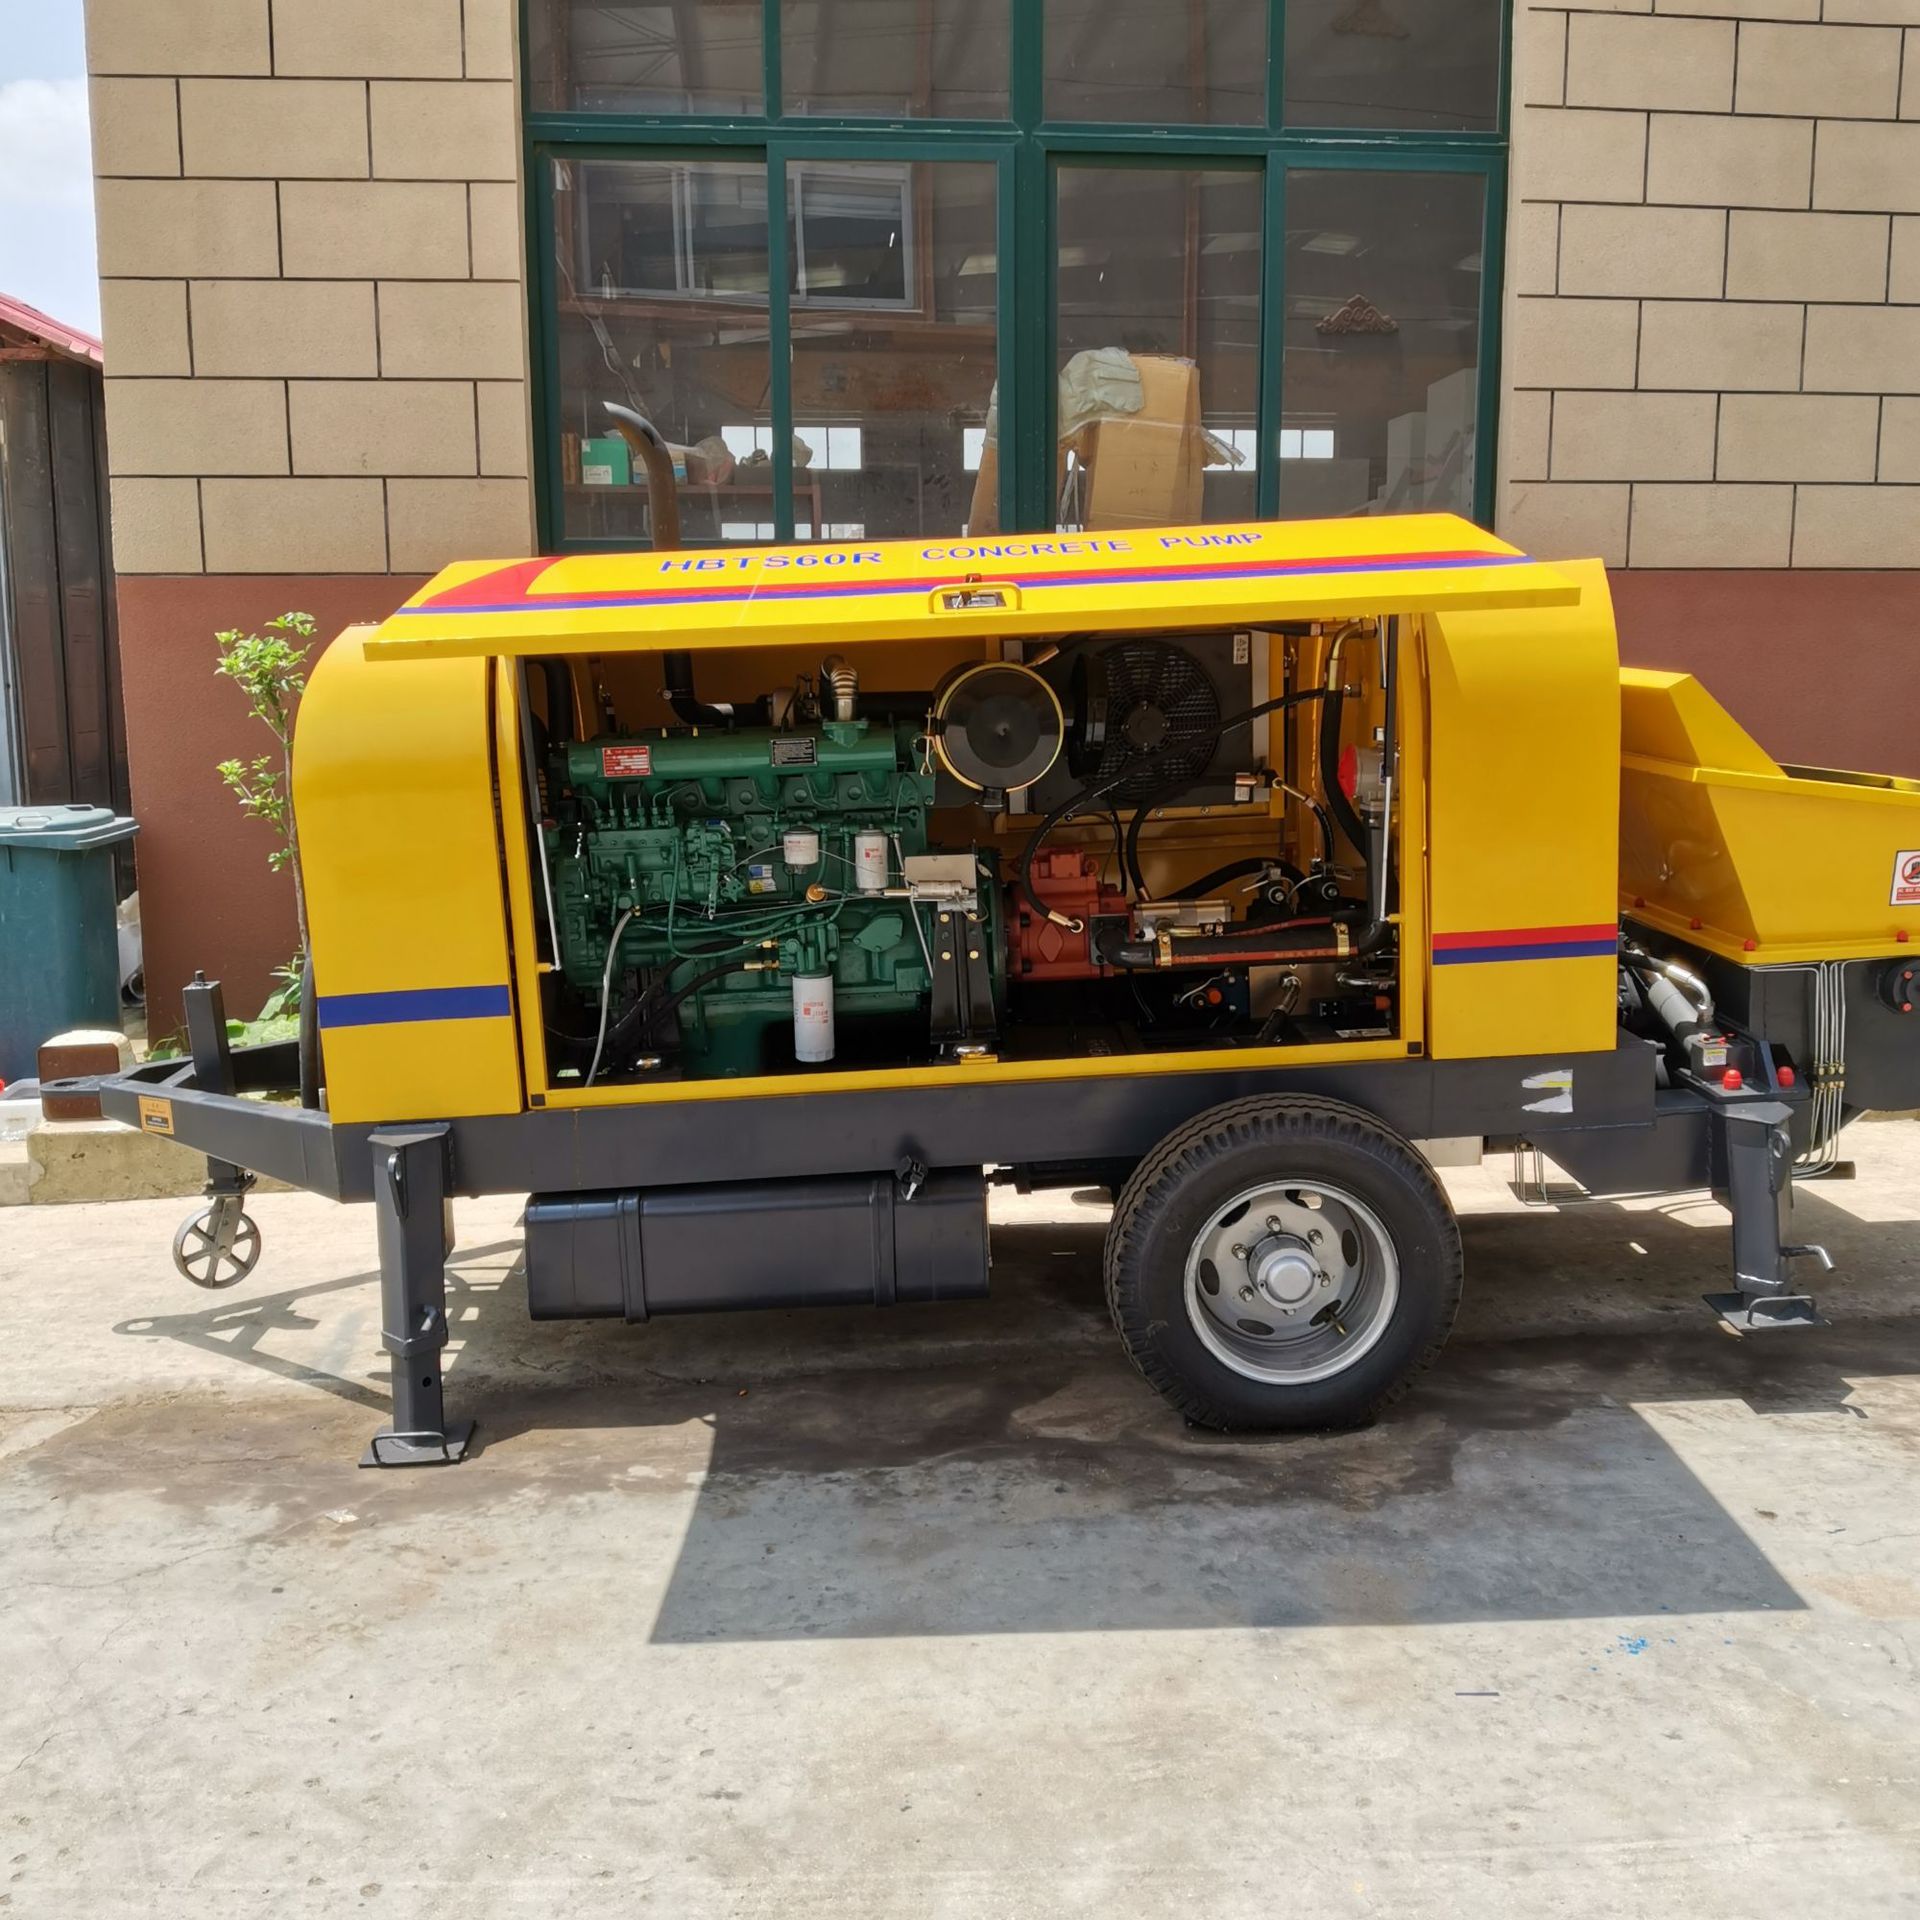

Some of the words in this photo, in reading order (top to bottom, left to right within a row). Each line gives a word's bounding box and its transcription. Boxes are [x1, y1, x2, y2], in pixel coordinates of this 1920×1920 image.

[660, 552, 882, 572] HBTS60R
[922, 539, 1133, 561] CONCRETE
[1159, 532, 1263, 549] PUMP
